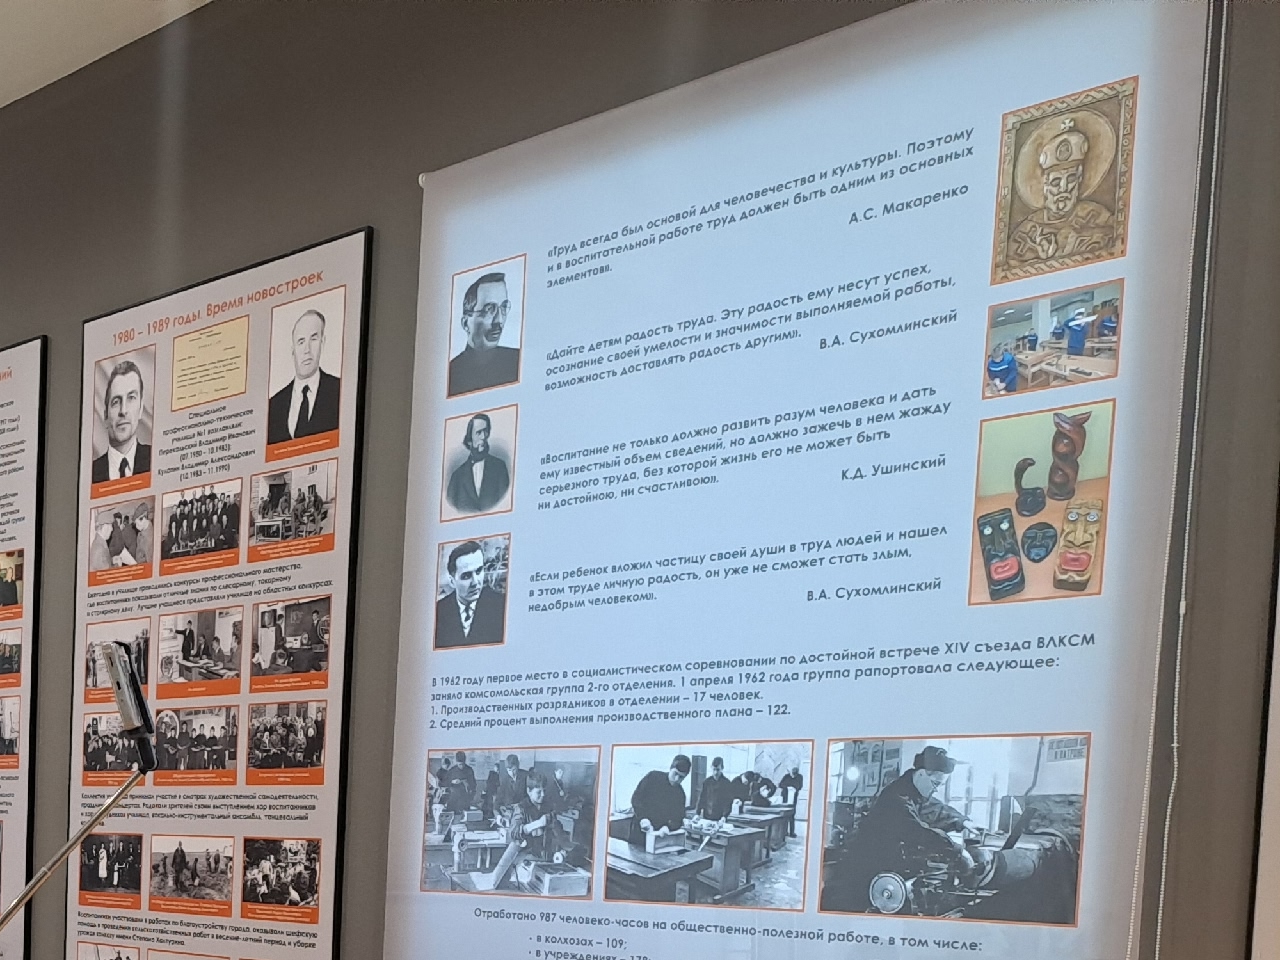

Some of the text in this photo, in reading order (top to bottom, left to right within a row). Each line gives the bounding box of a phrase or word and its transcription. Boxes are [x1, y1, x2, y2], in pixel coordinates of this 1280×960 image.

[564, 145, 974, 269] воспитательной работе труд должен быть одним основных
[579, 126, 974, 249] всегда был основой для человечества культуры. Поэтому
[848, 184, 969, 225] А.С. Макаренко
[112, 327, 135, 347] 1980
[146, 316, 170, 336] 1989
[206, 295, 244, 319] Время
[246, 269, 324, 304] новостроек
[545, 276, 956, 377] осознание своей умелости значимости выполняемой работы,
[587, 263, 932, 353] детям радость труда. Эту радость ему несут успех,
[819, 308, 957, 350] В.А. Сухомлинский
[539, 401, 952, 480] ему известный объем сведений, должно зажечь нем жажду
[629, 386, 937, 449] только должно развить разум человека дать
[538, 429, 891, 496] серьезного труда, без которой жизнь его может быть
[841, 452, 946, 481] К.Д. Ушинский
[537, 547, 912, 597] этом труде личную радость, уже сможет стать злым,
[562, 525, 948, 582] ребенок вложил частицу своей души труд людей нашел
[806, 576, 942, 602] В.А. Сухомлинский
[439, 632, 1095, 687] 1962 году первое место социалистическом соревновании достойной встрече XIV съезда ВЛКСМ
[463, 656, 1060, 699] комсомольская группа 2-го отделения. апреля 1962 года группа рапортовала следующее:
[439, 703, 791, 731] Средний процент выполнения производственного плана 122.
[473, 907, 983, 952] Отработано 987 человеко-часов общественно-полезной работе, том числе:
